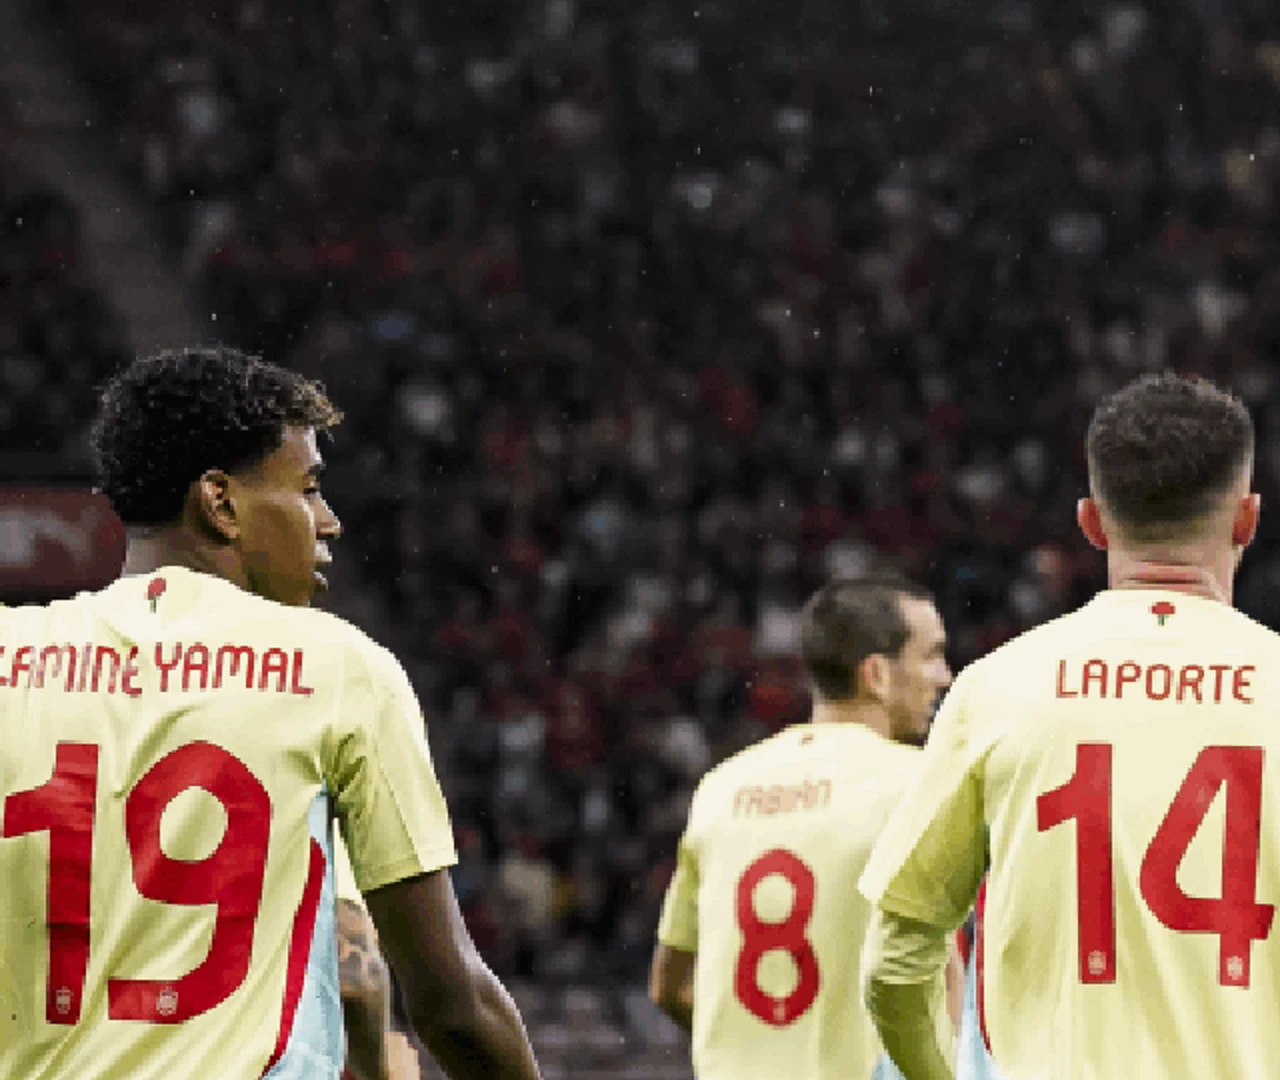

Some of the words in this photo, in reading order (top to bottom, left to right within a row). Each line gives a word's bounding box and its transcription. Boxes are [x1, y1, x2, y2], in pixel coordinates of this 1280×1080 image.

[154, 642, 314, 697] YAMAL
[1054, 657, 1257, 704] LAPORTE
[2, 740, 272, 1025] 19
[732, 848, 821, 1027] 8
[1036, 743, 1276, 988] 14
